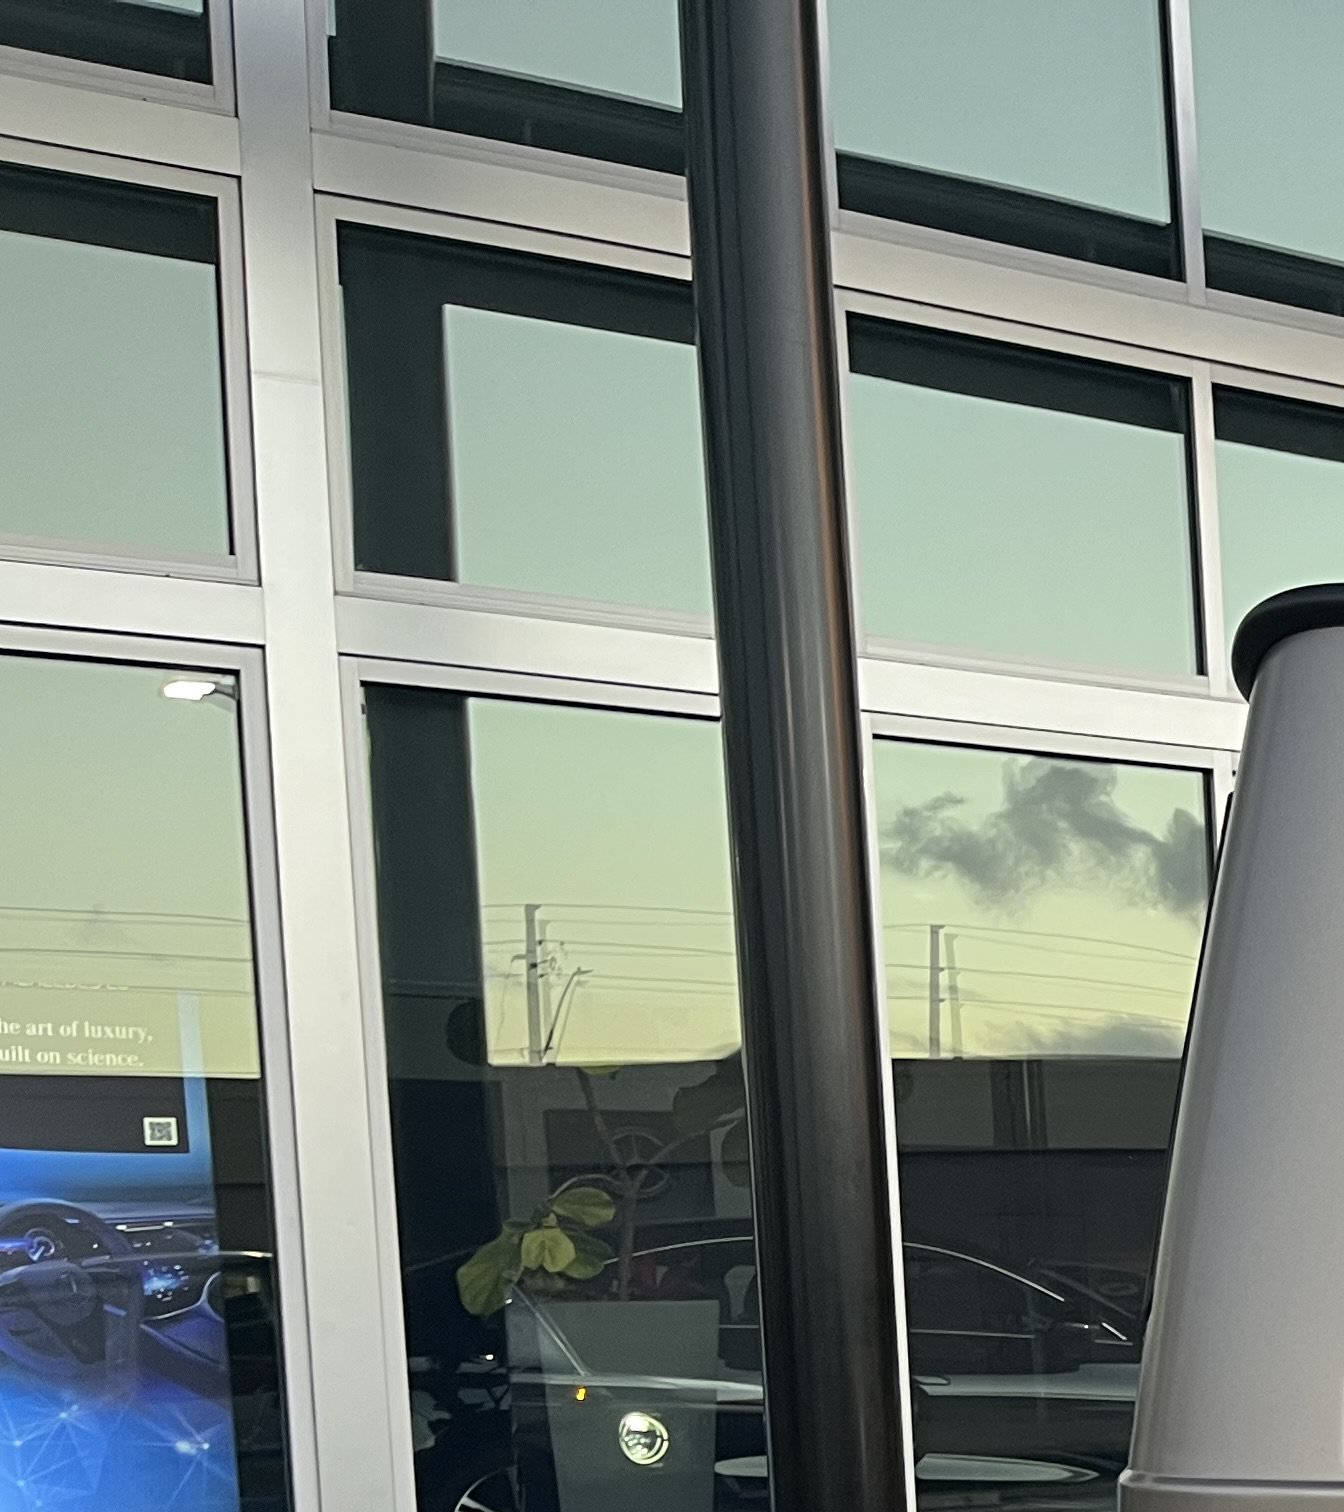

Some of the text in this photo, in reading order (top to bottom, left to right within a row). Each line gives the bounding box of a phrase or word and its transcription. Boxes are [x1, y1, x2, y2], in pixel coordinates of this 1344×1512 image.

[26, 1022, 53, 1036] art
[59, 1021, 78, 1037] of
[84, 1021, 153, 1044] luxury,
[36, 1051, 61, 1065] on
[67, 1049, 144, 1067] science.
